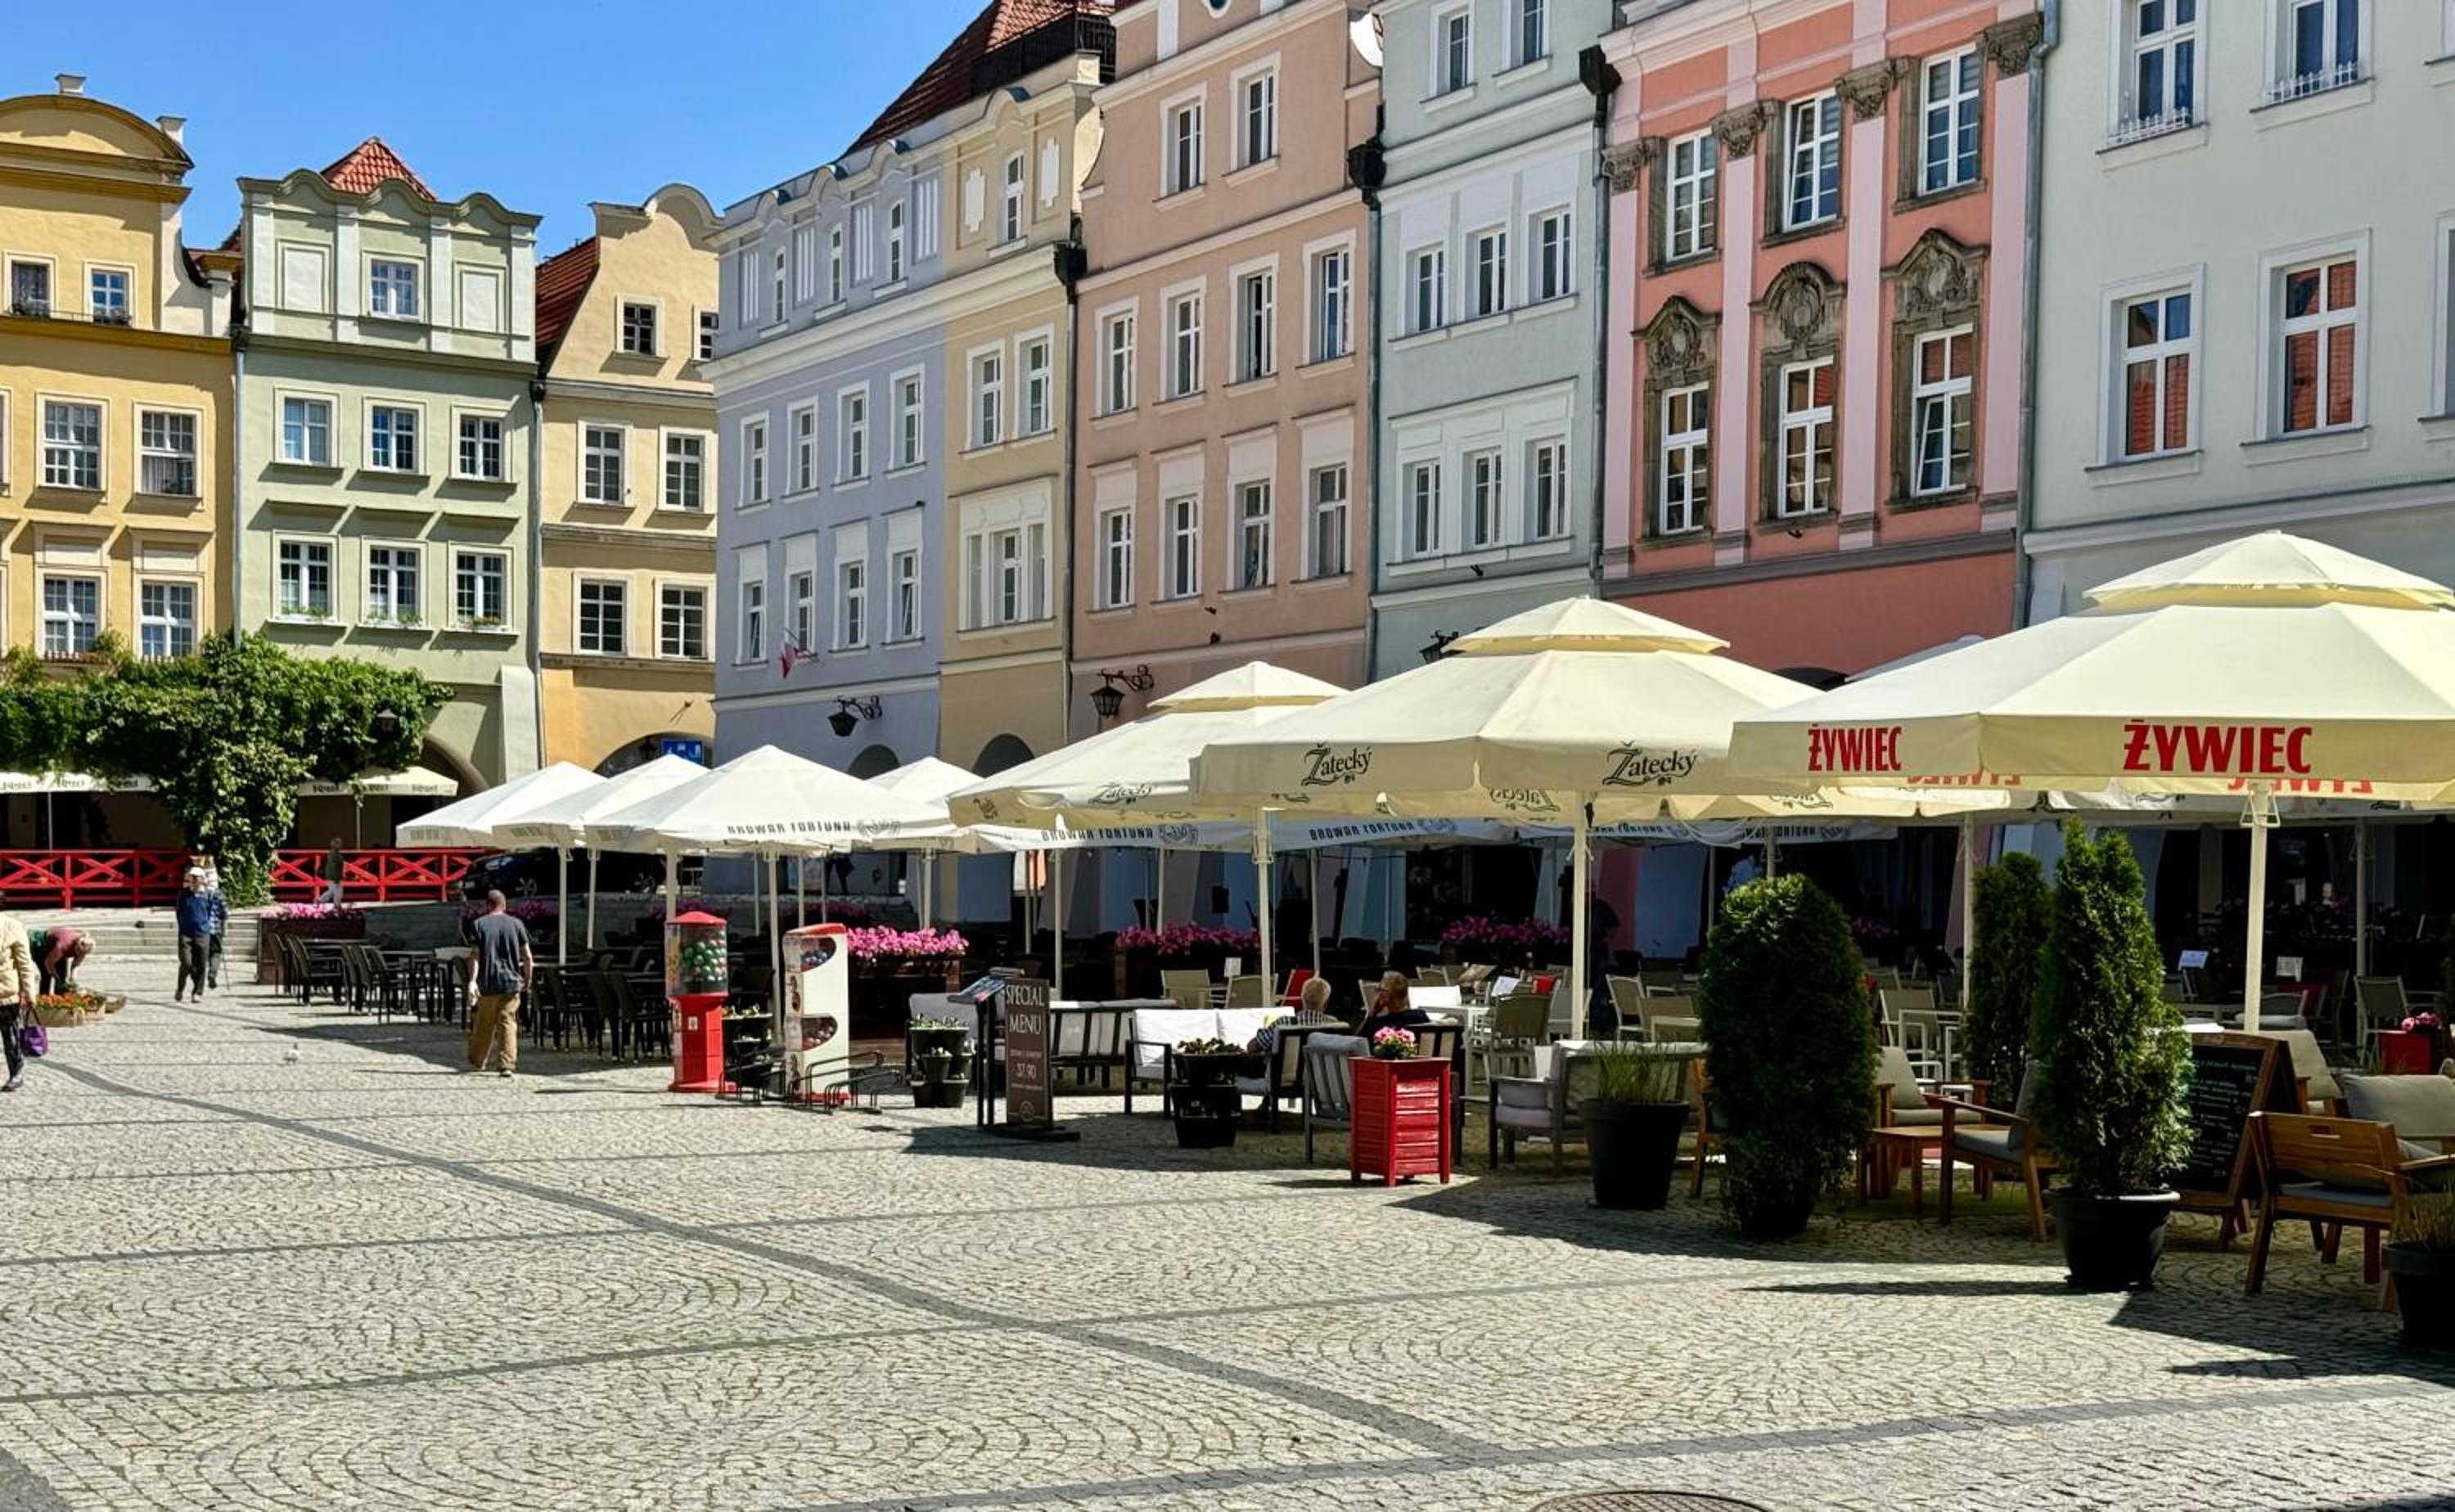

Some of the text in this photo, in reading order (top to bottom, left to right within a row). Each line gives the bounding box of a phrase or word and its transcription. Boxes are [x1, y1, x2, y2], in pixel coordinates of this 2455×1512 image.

[1808, 723, 1903, 772] ŻYWIEC
[2123, 718, 2312, 774] ŻYWIEC
[1301, 742, 1372, 786] Žatecký
[1601, 740, 1698, 786] Žatecký
[1099, 826, 1153, 840] FORTUNA
[1309, 826, 1360, 841] BROWAR
[1363, 820, 1415, 835] FORTUNA
[1006, 984, 1045, 1006] SPECIAL
[1009, 1014, 1042, 1034] MENU
